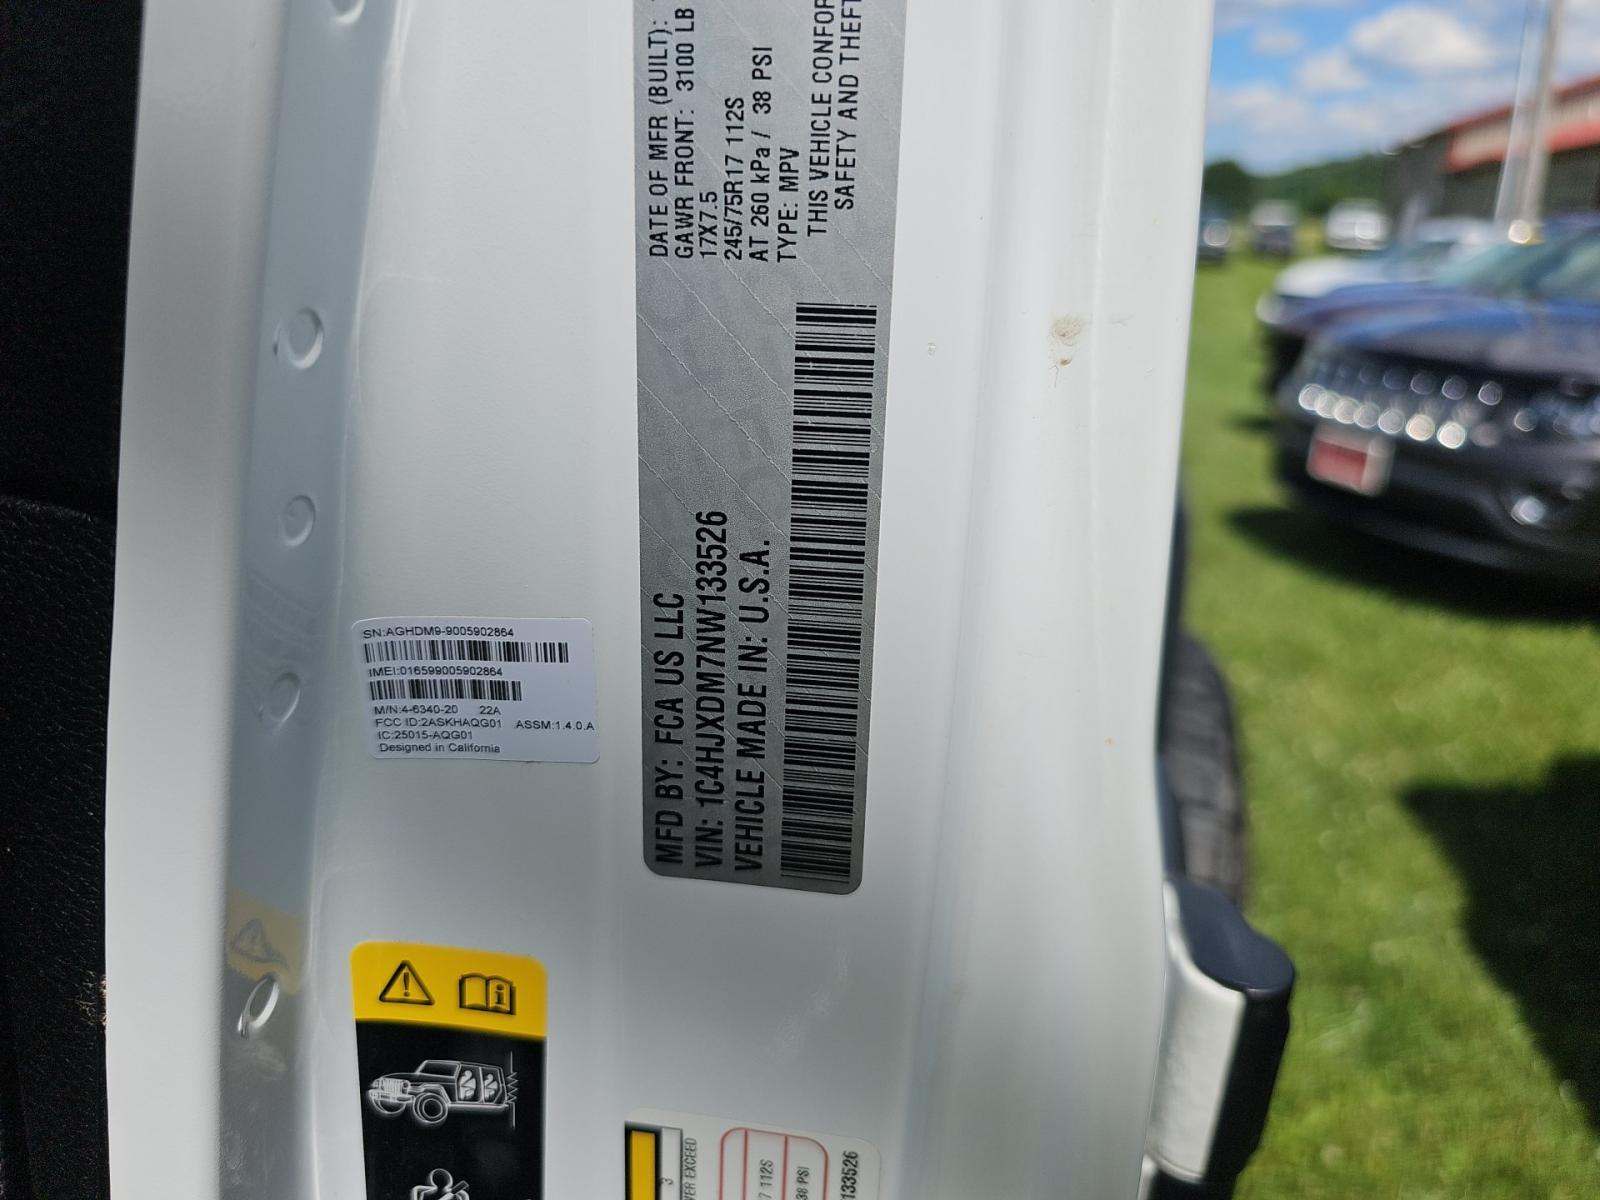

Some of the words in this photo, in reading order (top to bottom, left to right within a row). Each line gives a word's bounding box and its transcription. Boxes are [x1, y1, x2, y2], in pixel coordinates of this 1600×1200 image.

[675, 8, 695, 32] LB
[648, 20, 672, 106] (BUILT):
[675, 43, 695, 91] 3100
[752, 47, 773, 80] PSI
[752, 90, 772, 115] 38
[838, 74, 859, 120] AND
[648, 115, 668, 161] MFR
[724, 97, 745, 146] 112S
[751, 130, 771, 139] /
[809, 93, 832, 181] VEHICLE
[674, 109, 694, 187] FRONT:
[750, 147, 771, 184] kPa
[779, 147, 800, 192] MPV
[834, 129, 857, 210] SAFETY
[649, 171, 668, 197] OF
[723, 154, 743, 260] 245/75R17
[649, 206, 669, 257] DATE
[674, 195, 694, 259] GAWR
[698, 191, 718, 258] 17X7.5
[750, 192, 770, 227] 260
[777, 203, 798, 262] TYPE:
[807, 190, 829, 237] THIS
[749, 236, 768, 262] AT
[738, 540, 771, 624] U.S.A.
[653, 592, 685, 640] LLC
[369, 667, 503, 677] IMEI:016599005902864
[653, 649, 685, 686] US
[695, 510, 729, 806] 1C4HJXDM7NW133526
[737, 635, 768, 673] IN:
[375, 717, 401, 728] FCC
[405, 717, 502, 729] ID:2ASKHAQG01
[479, 705, 501, 716] 22A
[654, 696, 684, 745] FCA
[736, 684, 766, 760] MADE
[378, 730, 473, 741] IC:25015-AQG01
[379, 742, 432, 754] Designed
[434, 742, 446, 753] in
[448, 742, 501, 754] California
[654, 758, 684, 801] BY:
[654, 809, 683, 864] MFD
[734, 768, 764, 872] VEHICLE
[695, 819, 724, 868] VIN:
[684, 1138, 697, 1178] EXCEED
[797, 1166, 810, 1184] PSI
